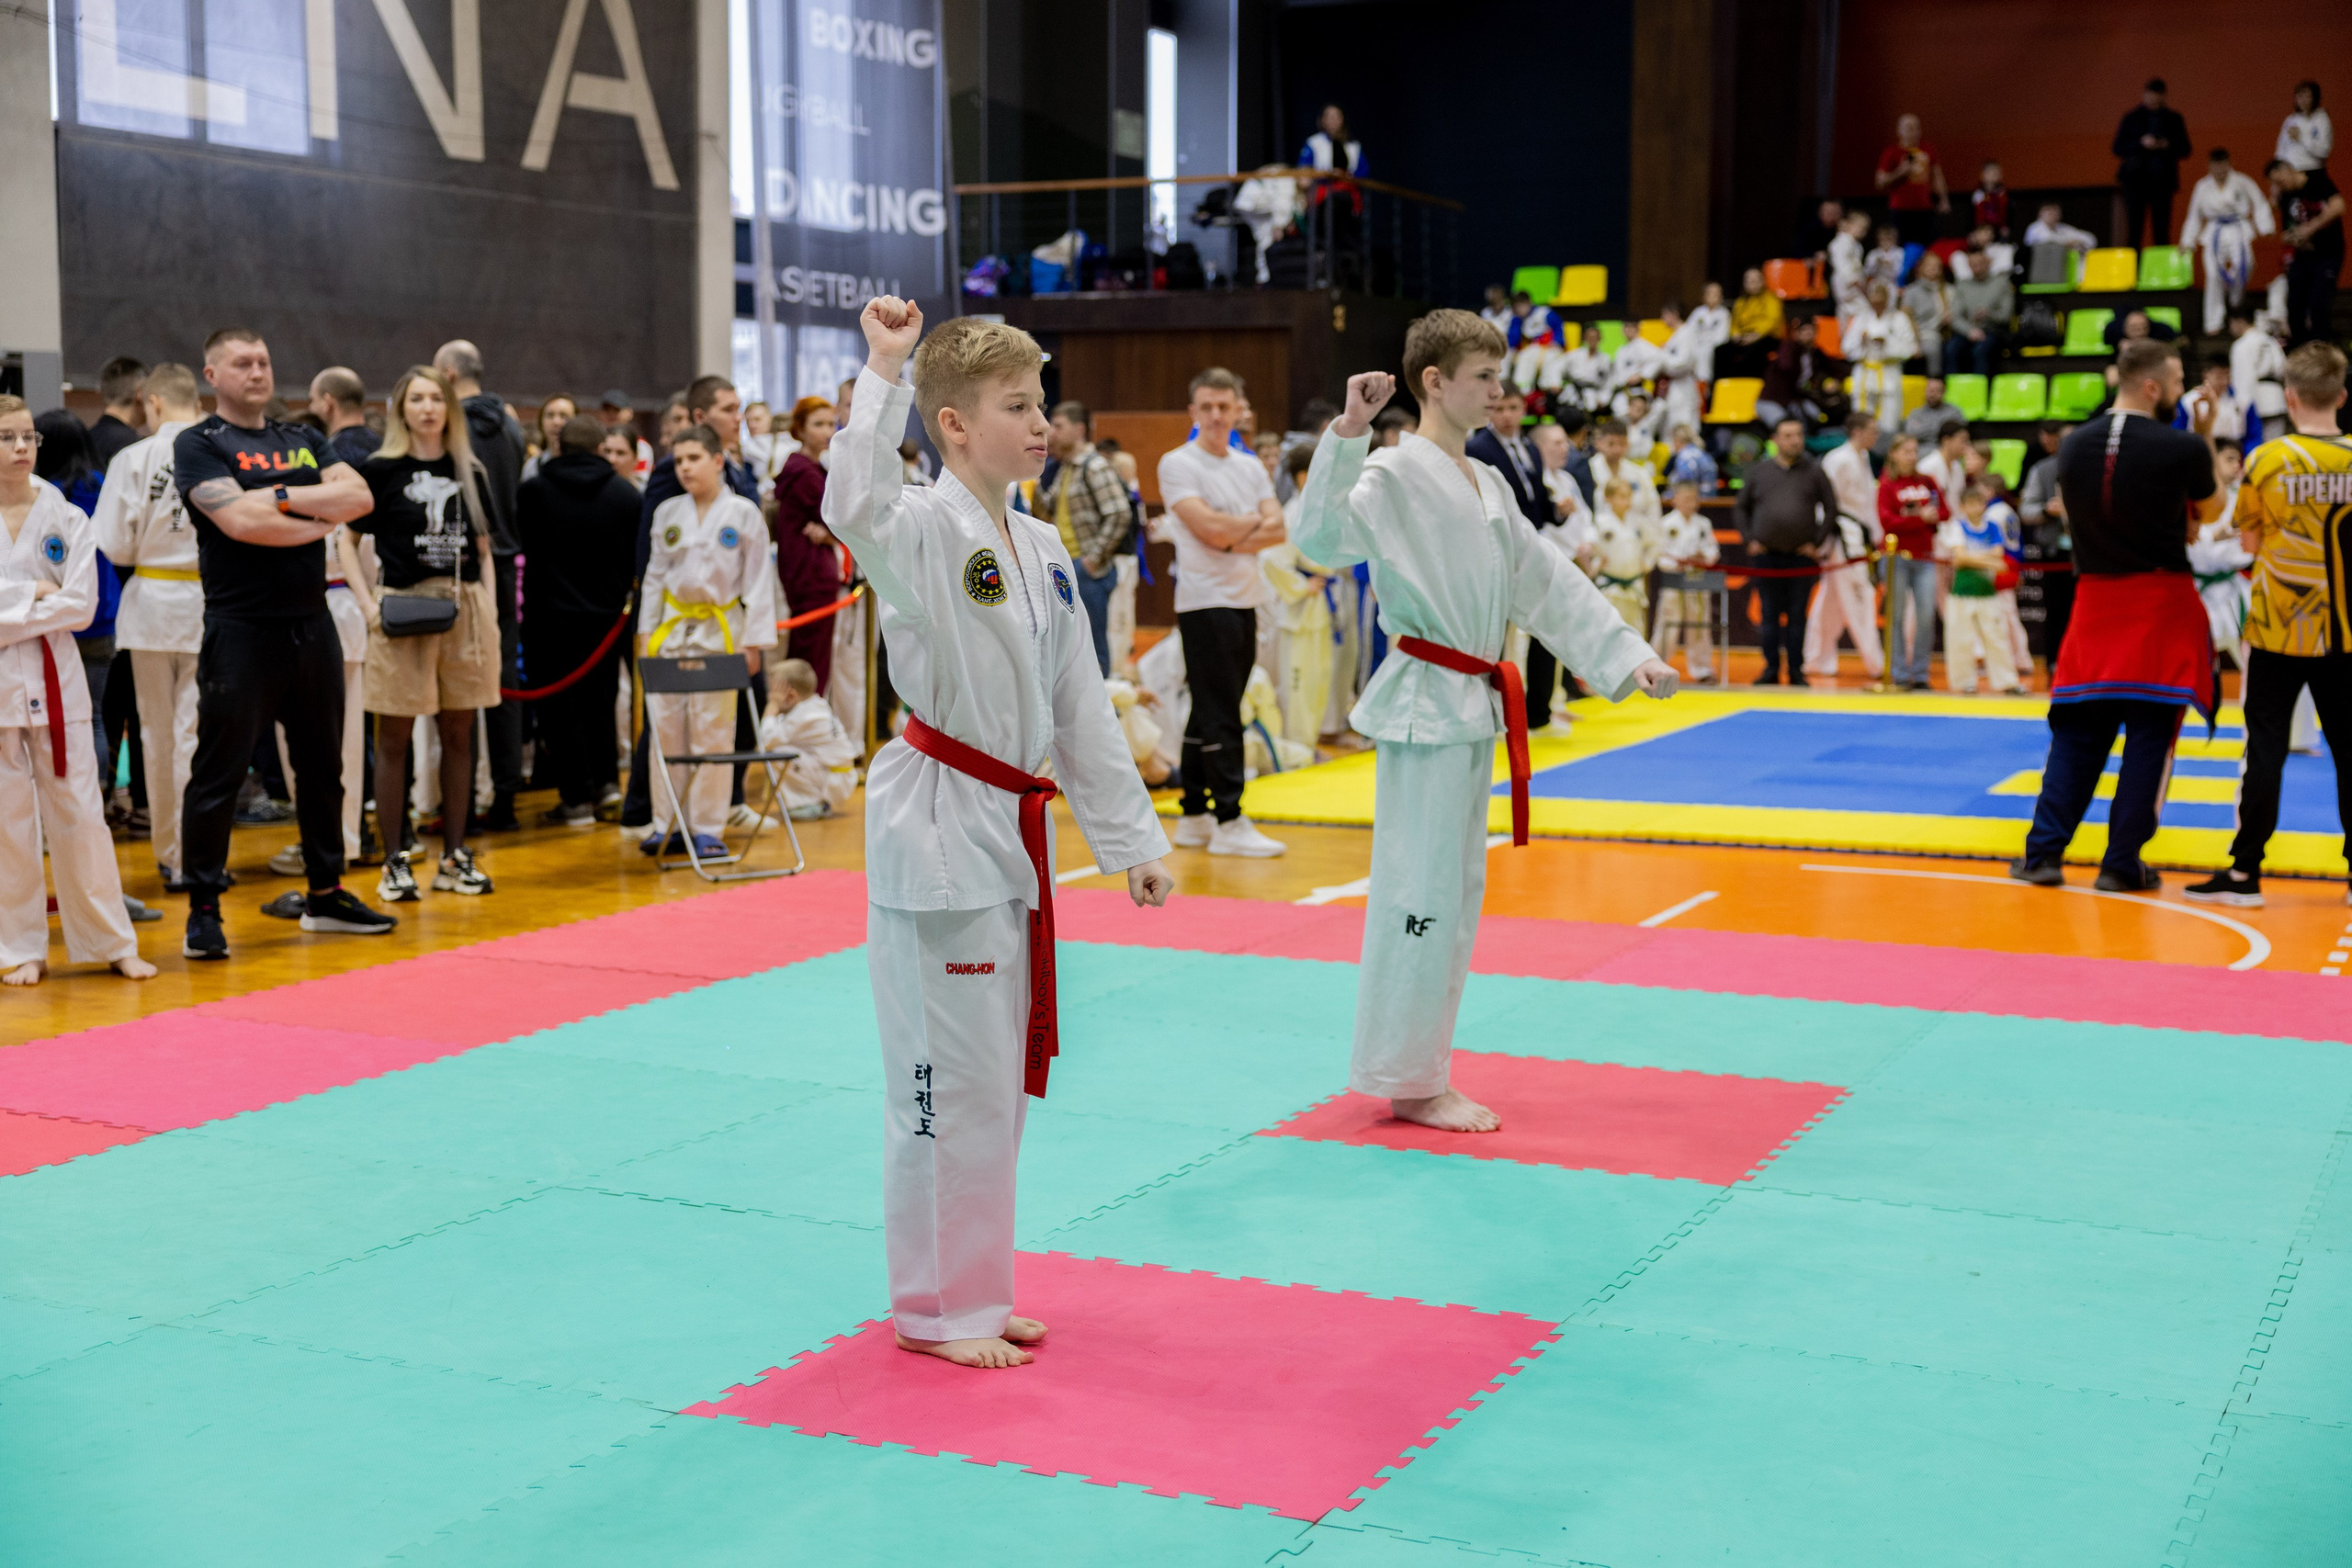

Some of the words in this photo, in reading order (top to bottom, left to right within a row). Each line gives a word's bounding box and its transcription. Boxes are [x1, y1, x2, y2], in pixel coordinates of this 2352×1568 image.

[808, 7, 937, 69] BOXING
[273, 447, 318, 470] UA
[945, 962, 995, 975] CHANG-HON
[1028, 1022, 1049, 1071] Team
